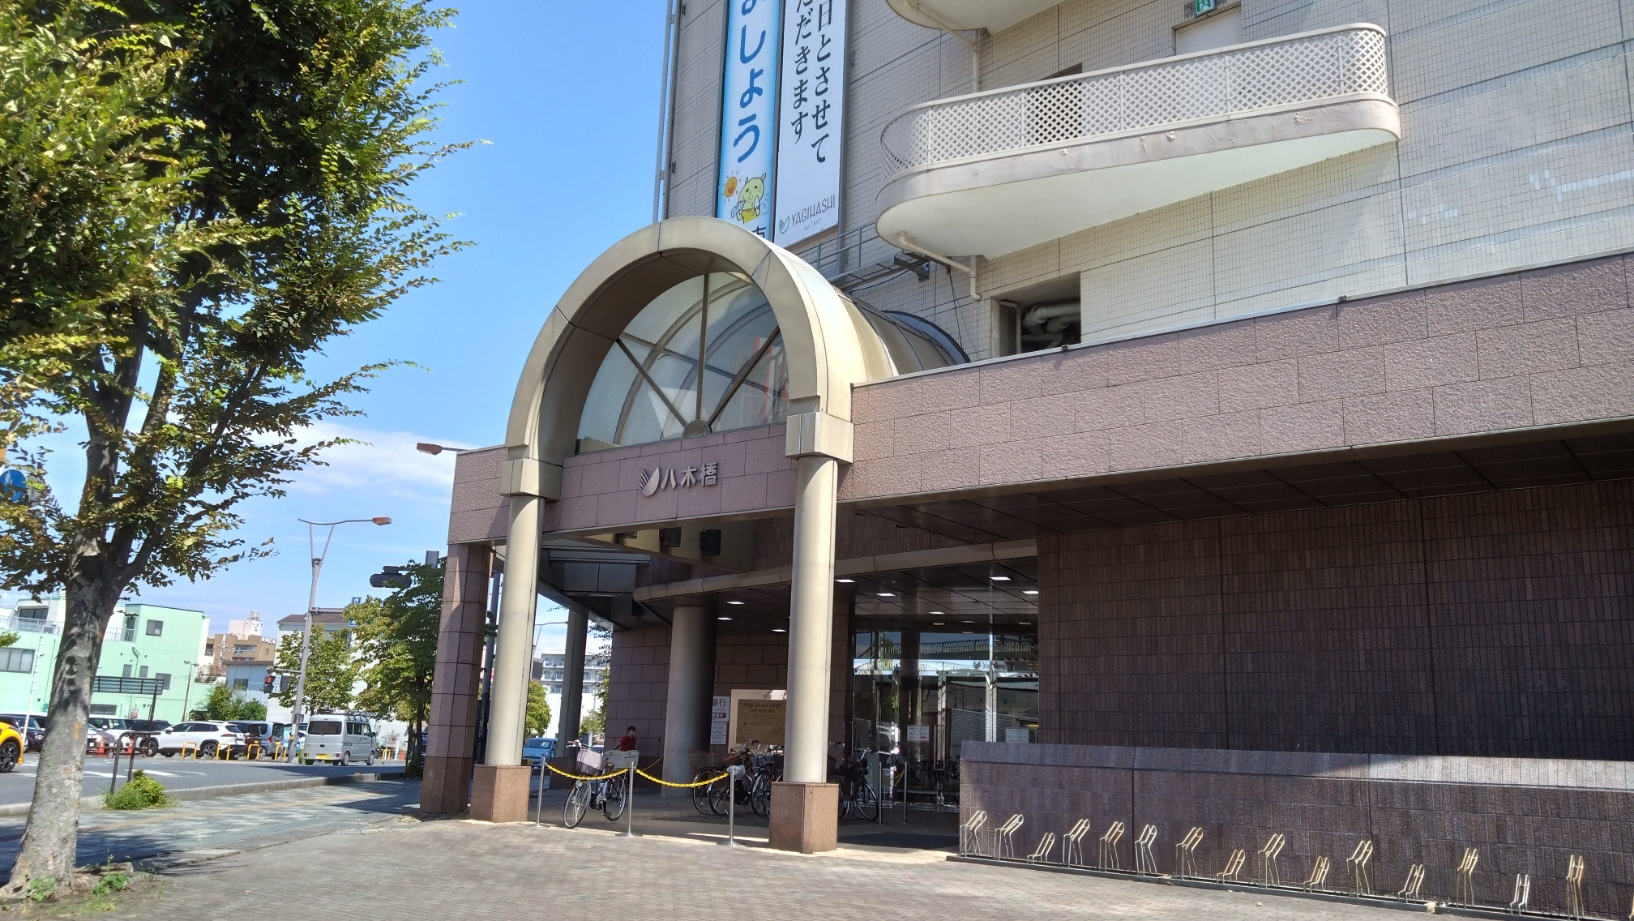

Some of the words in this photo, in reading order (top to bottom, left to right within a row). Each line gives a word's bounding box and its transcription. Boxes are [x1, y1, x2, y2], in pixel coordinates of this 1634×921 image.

[791, 194, 836, 227] YAGIHASHI
[660, 462, 719, 491] 八木橋
